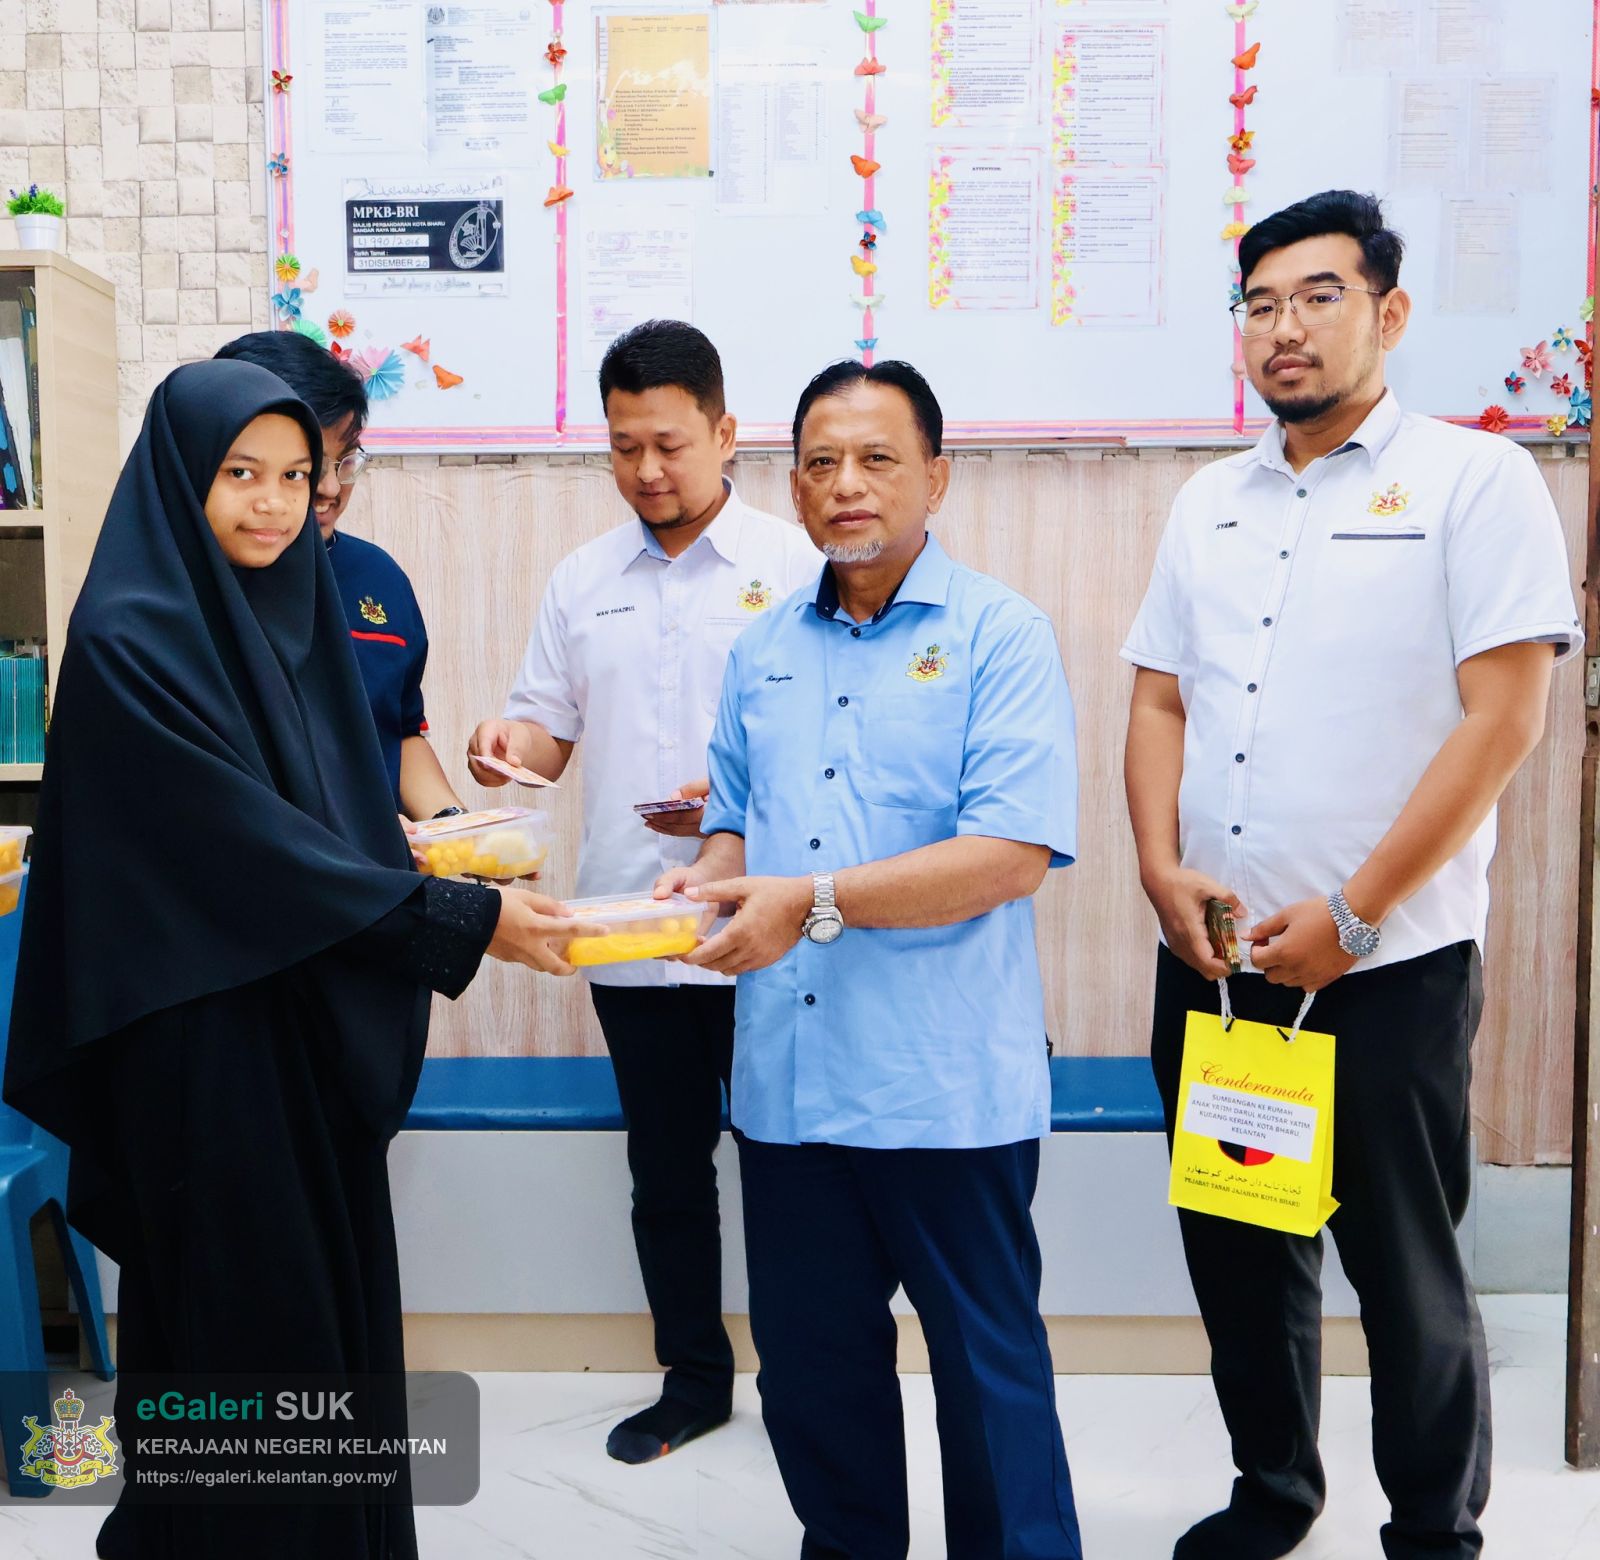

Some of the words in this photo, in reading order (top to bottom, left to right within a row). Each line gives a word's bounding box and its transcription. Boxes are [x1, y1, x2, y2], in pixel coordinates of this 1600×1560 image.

[353, 205, 419, 219] MPKB-BRI
[1200, 1061, 1315, 1102] Cenderamata
[1191, 1099, 1210, 1108] ANAK
[1211, 1103, 1232, 1112] YATIM
[1233, 1108, 1255, 1118] DARUL
[1257, 1112, 1288, 1124] KAUTSAR
[1212, 1094, 1256, 1109] SUMBANGAN
[1257, 1103, 1265, 1111] KE
[1267, 1105, 1293, 1116] RUMAH
[1231, 1126, 1267, 1140] KELANTAN
[1256, 1122, 1274, 1132] KOTA
[1184, 1176, 1209, 1188] PEJABAT
[1210, 1183, 1230, 1193] TANAH
[1231, 1188, 1259, 1199] JAJAHAN
[1260, 1194, 1278, 1203] KOTA
[1279, 1198, 1301, 1208] BHARU
